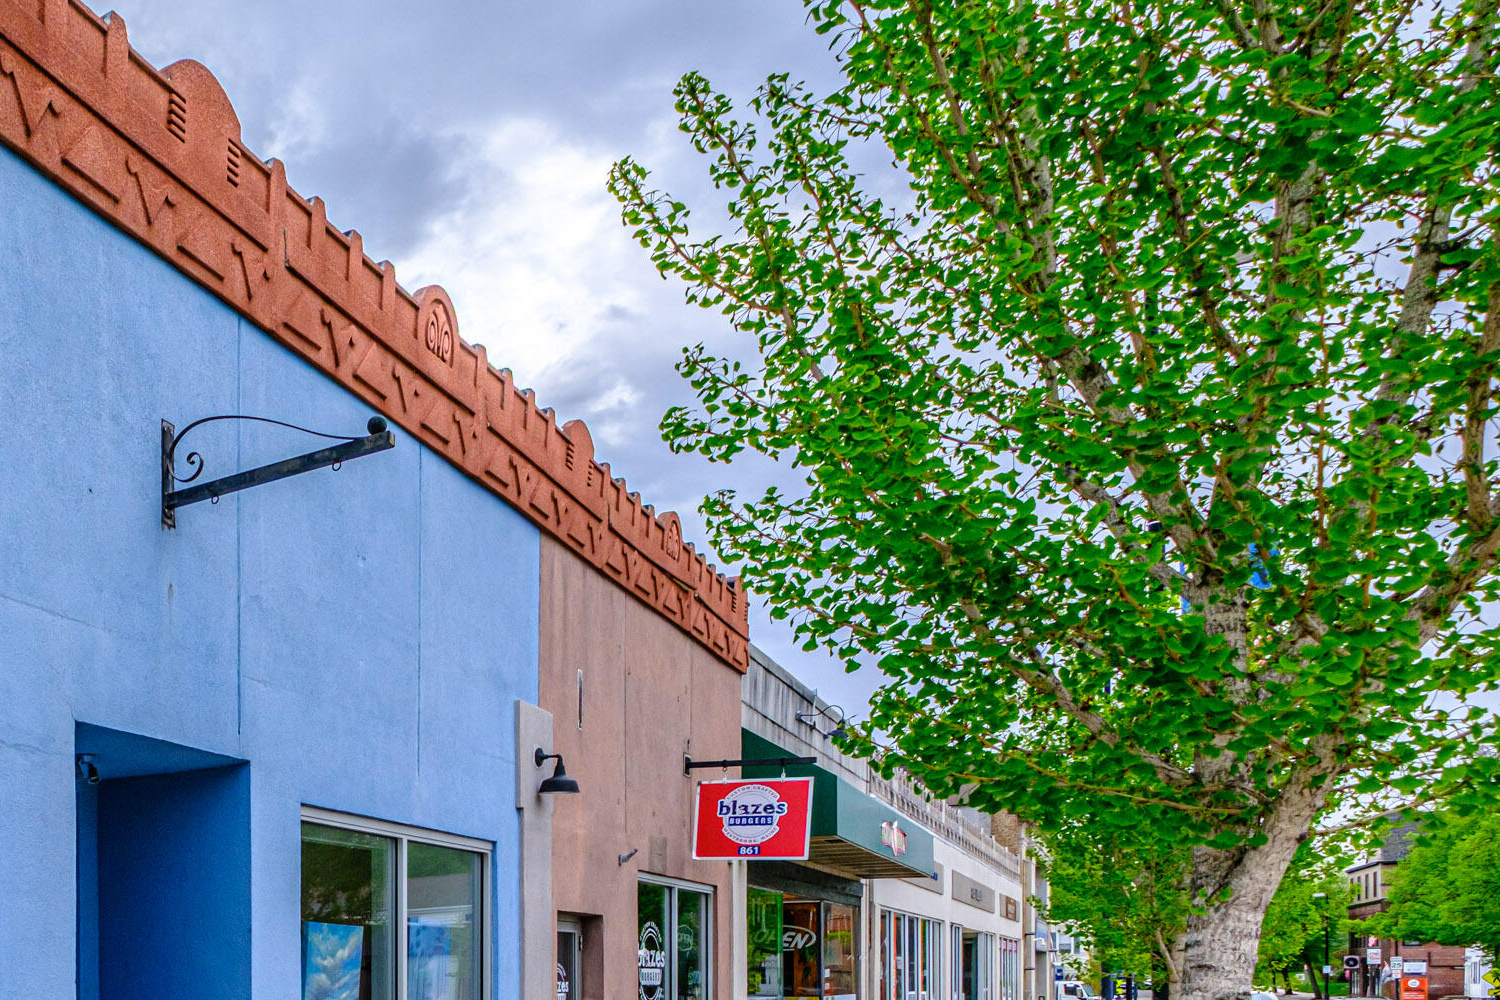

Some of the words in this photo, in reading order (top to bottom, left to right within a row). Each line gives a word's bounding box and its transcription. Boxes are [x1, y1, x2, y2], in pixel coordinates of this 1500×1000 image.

[719, 800, 786, 815] blazes
[729, 817, 773, 825] BURGERS
[739, 847, 759, 855] 861
